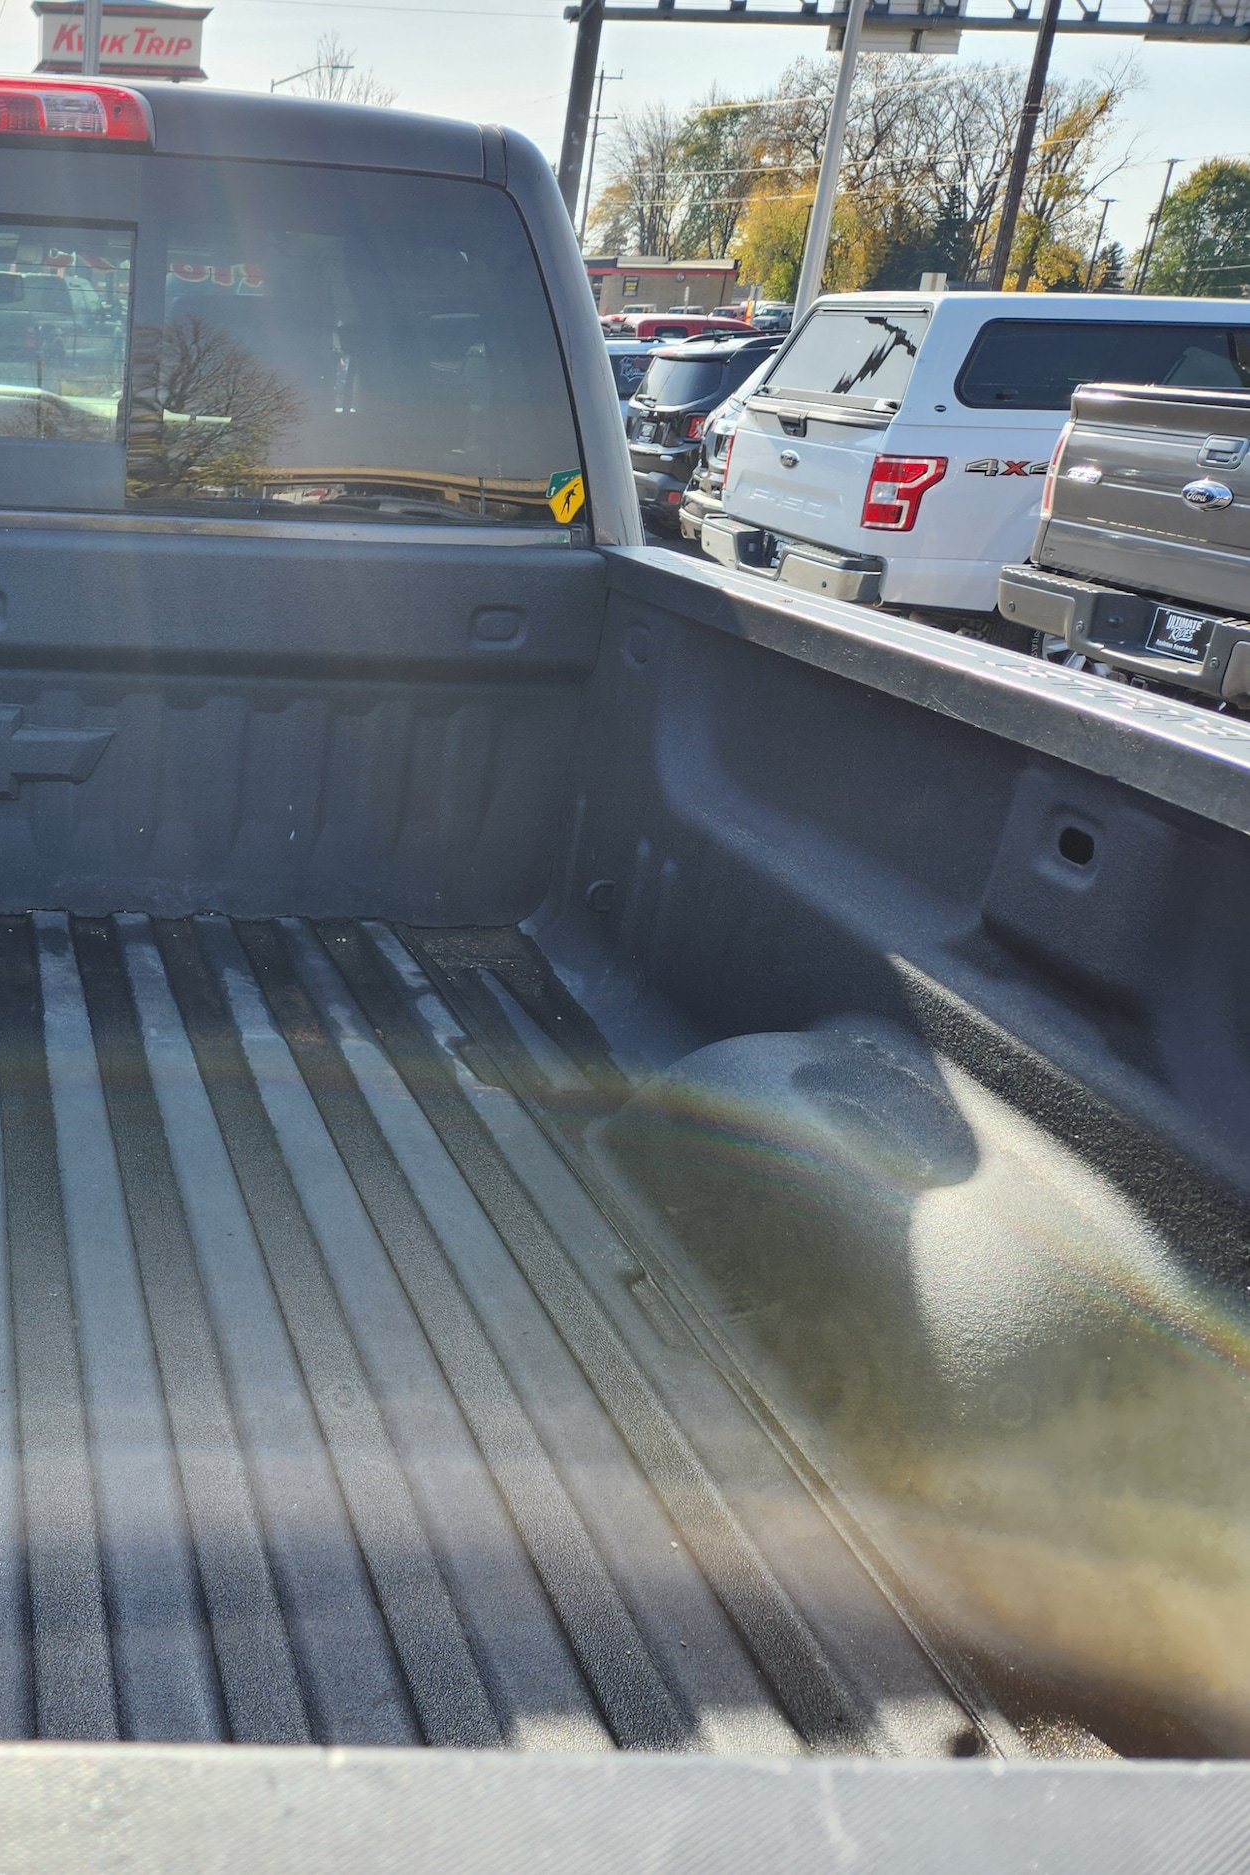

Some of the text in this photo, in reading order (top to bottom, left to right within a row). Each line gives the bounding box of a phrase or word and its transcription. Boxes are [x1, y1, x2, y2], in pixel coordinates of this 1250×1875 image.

[52, 24, 193, 56] KIK TRIP
[1166, 614, 1203, 631] ULTIMATE
[1168, 627, 1197, 642] RIDES
